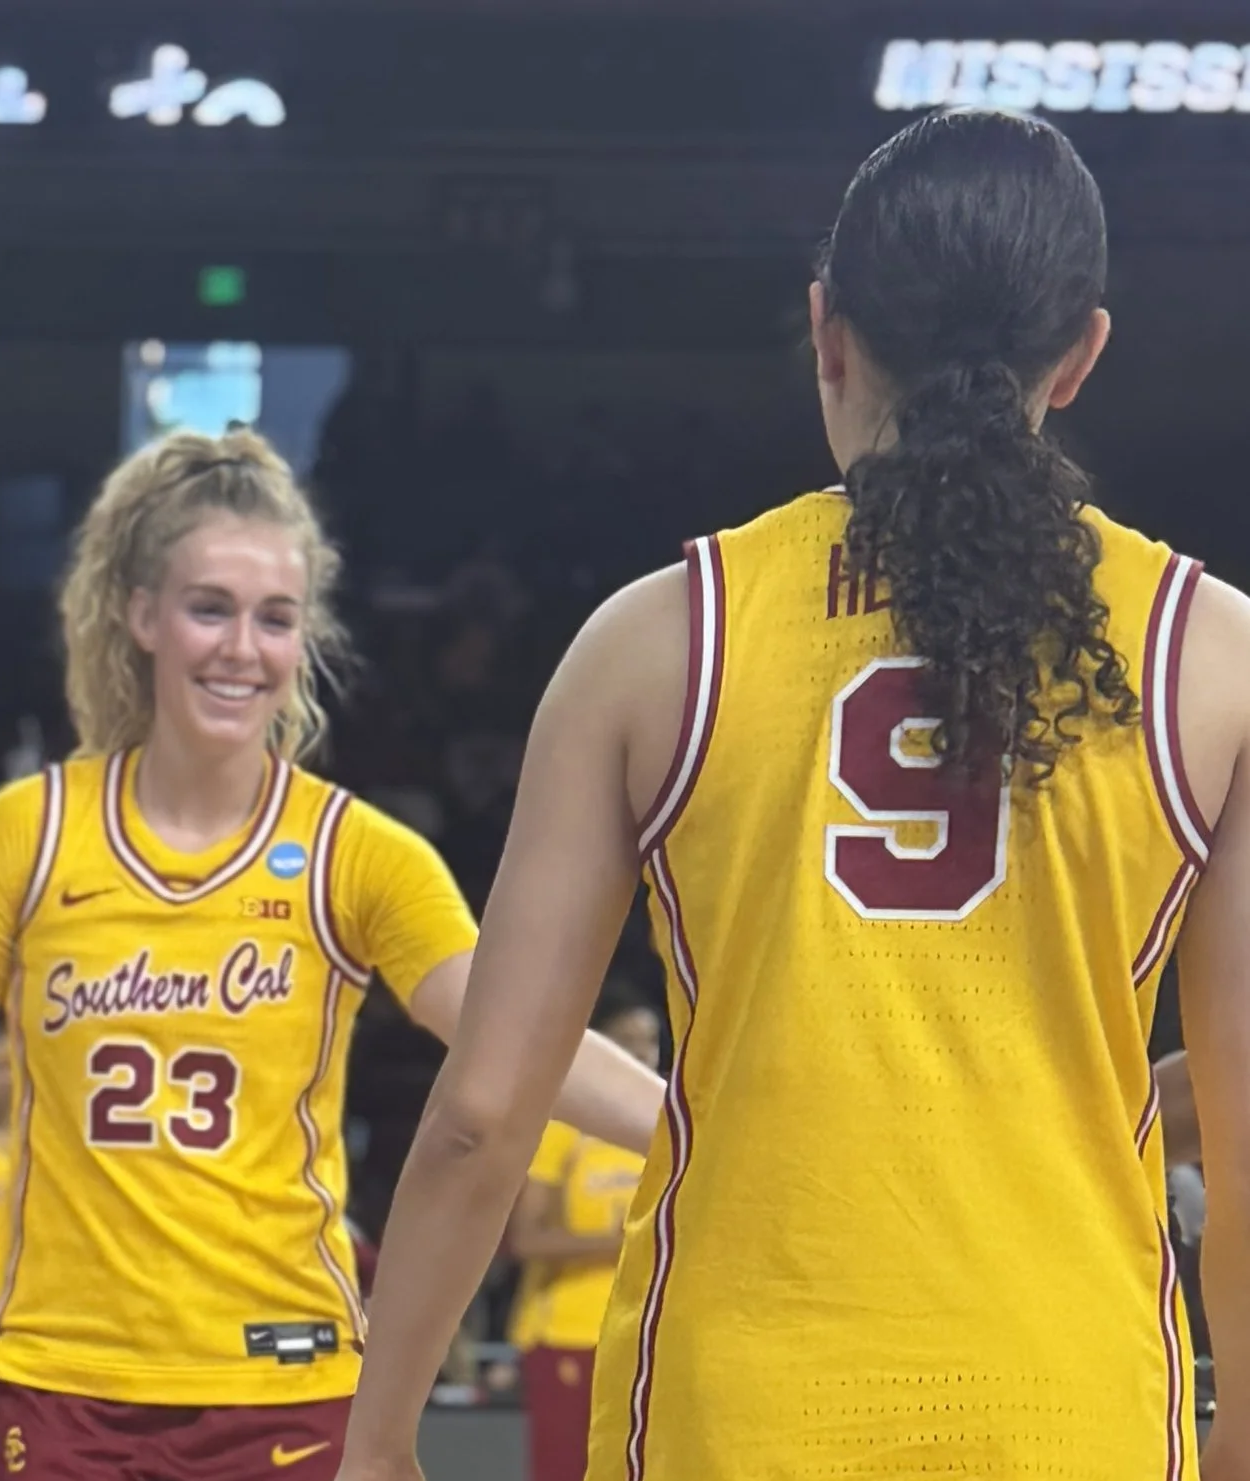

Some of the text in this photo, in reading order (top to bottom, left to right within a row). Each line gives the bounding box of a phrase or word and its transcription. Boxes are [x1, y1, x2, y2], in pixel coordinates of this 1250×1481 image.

[872, 38, 1250, 114] MISSISS
[825, 656, 1014, 922] 9
[41, 938, 297, 1036] Southern Cal
[86, 1037, 242, 1156] 23
